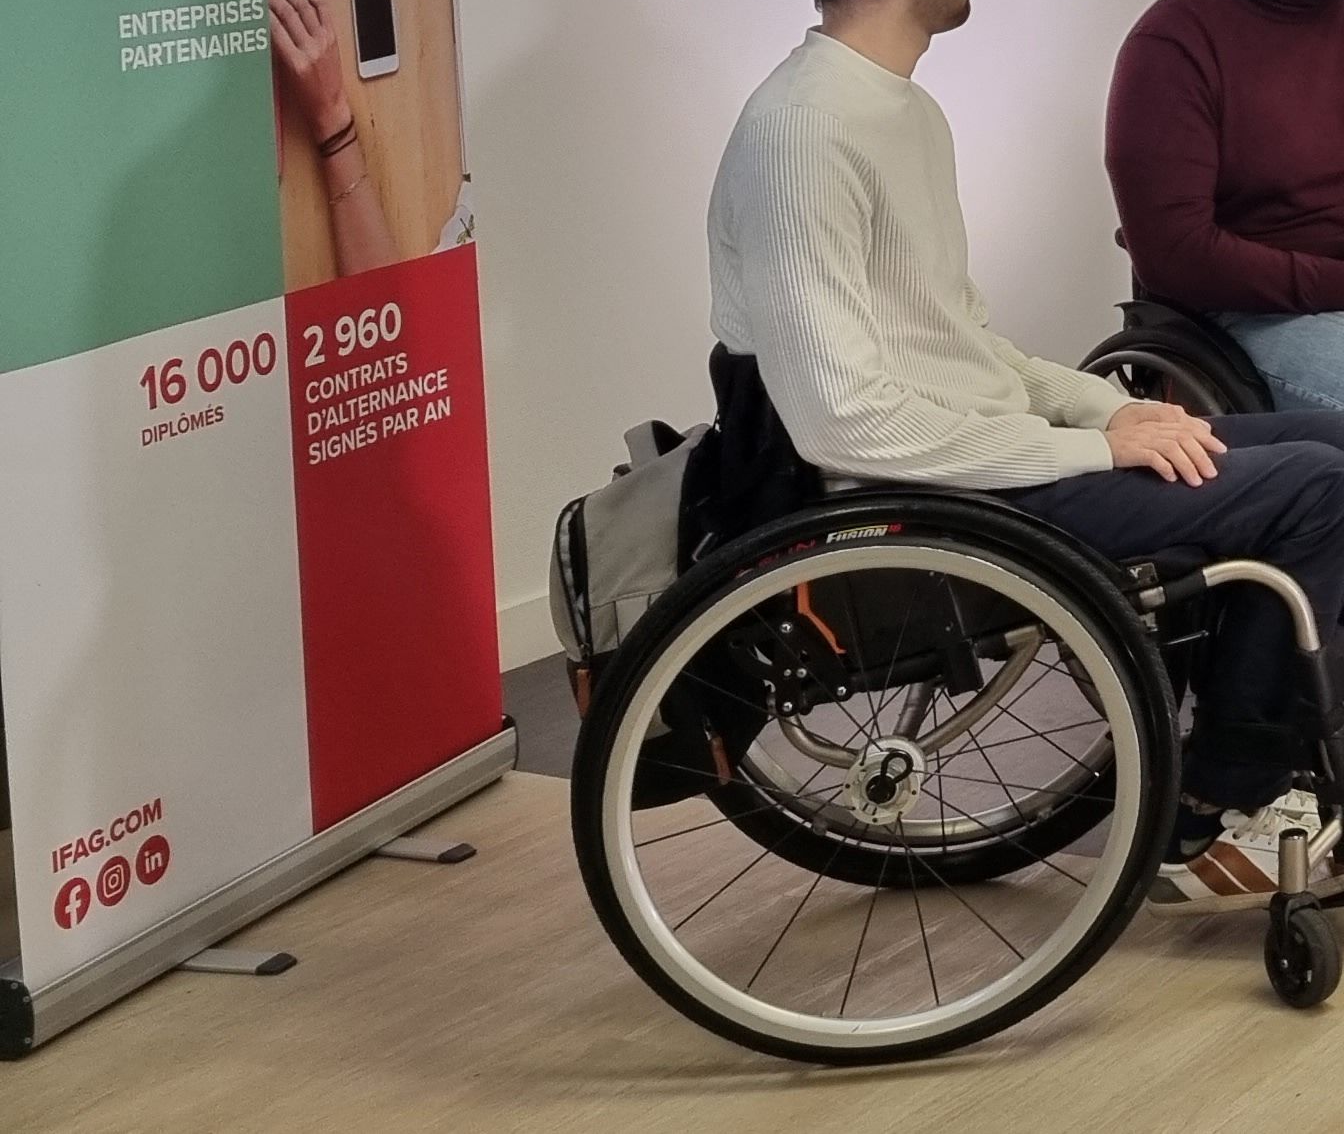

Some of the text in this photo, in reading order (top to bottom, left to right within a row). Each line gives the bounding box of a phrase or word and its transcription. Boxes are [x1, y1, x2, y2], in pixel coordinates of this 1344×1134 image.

[121, 27, 268, 72] PARTENAIRES
[303, 302, 402, 368] 2 960
[139, 332, 277, 410] 16 000
[305, 352, 408, 404] CONTRATS
[307, 368, 448, 435] D'ALTERNANCE
[141, 403, 225, 447] DIPLÔMÉS
[309, 396, 451, 465] SIGNÉS PAR AN
[51, 797, 163, 874] IFAG.COM
